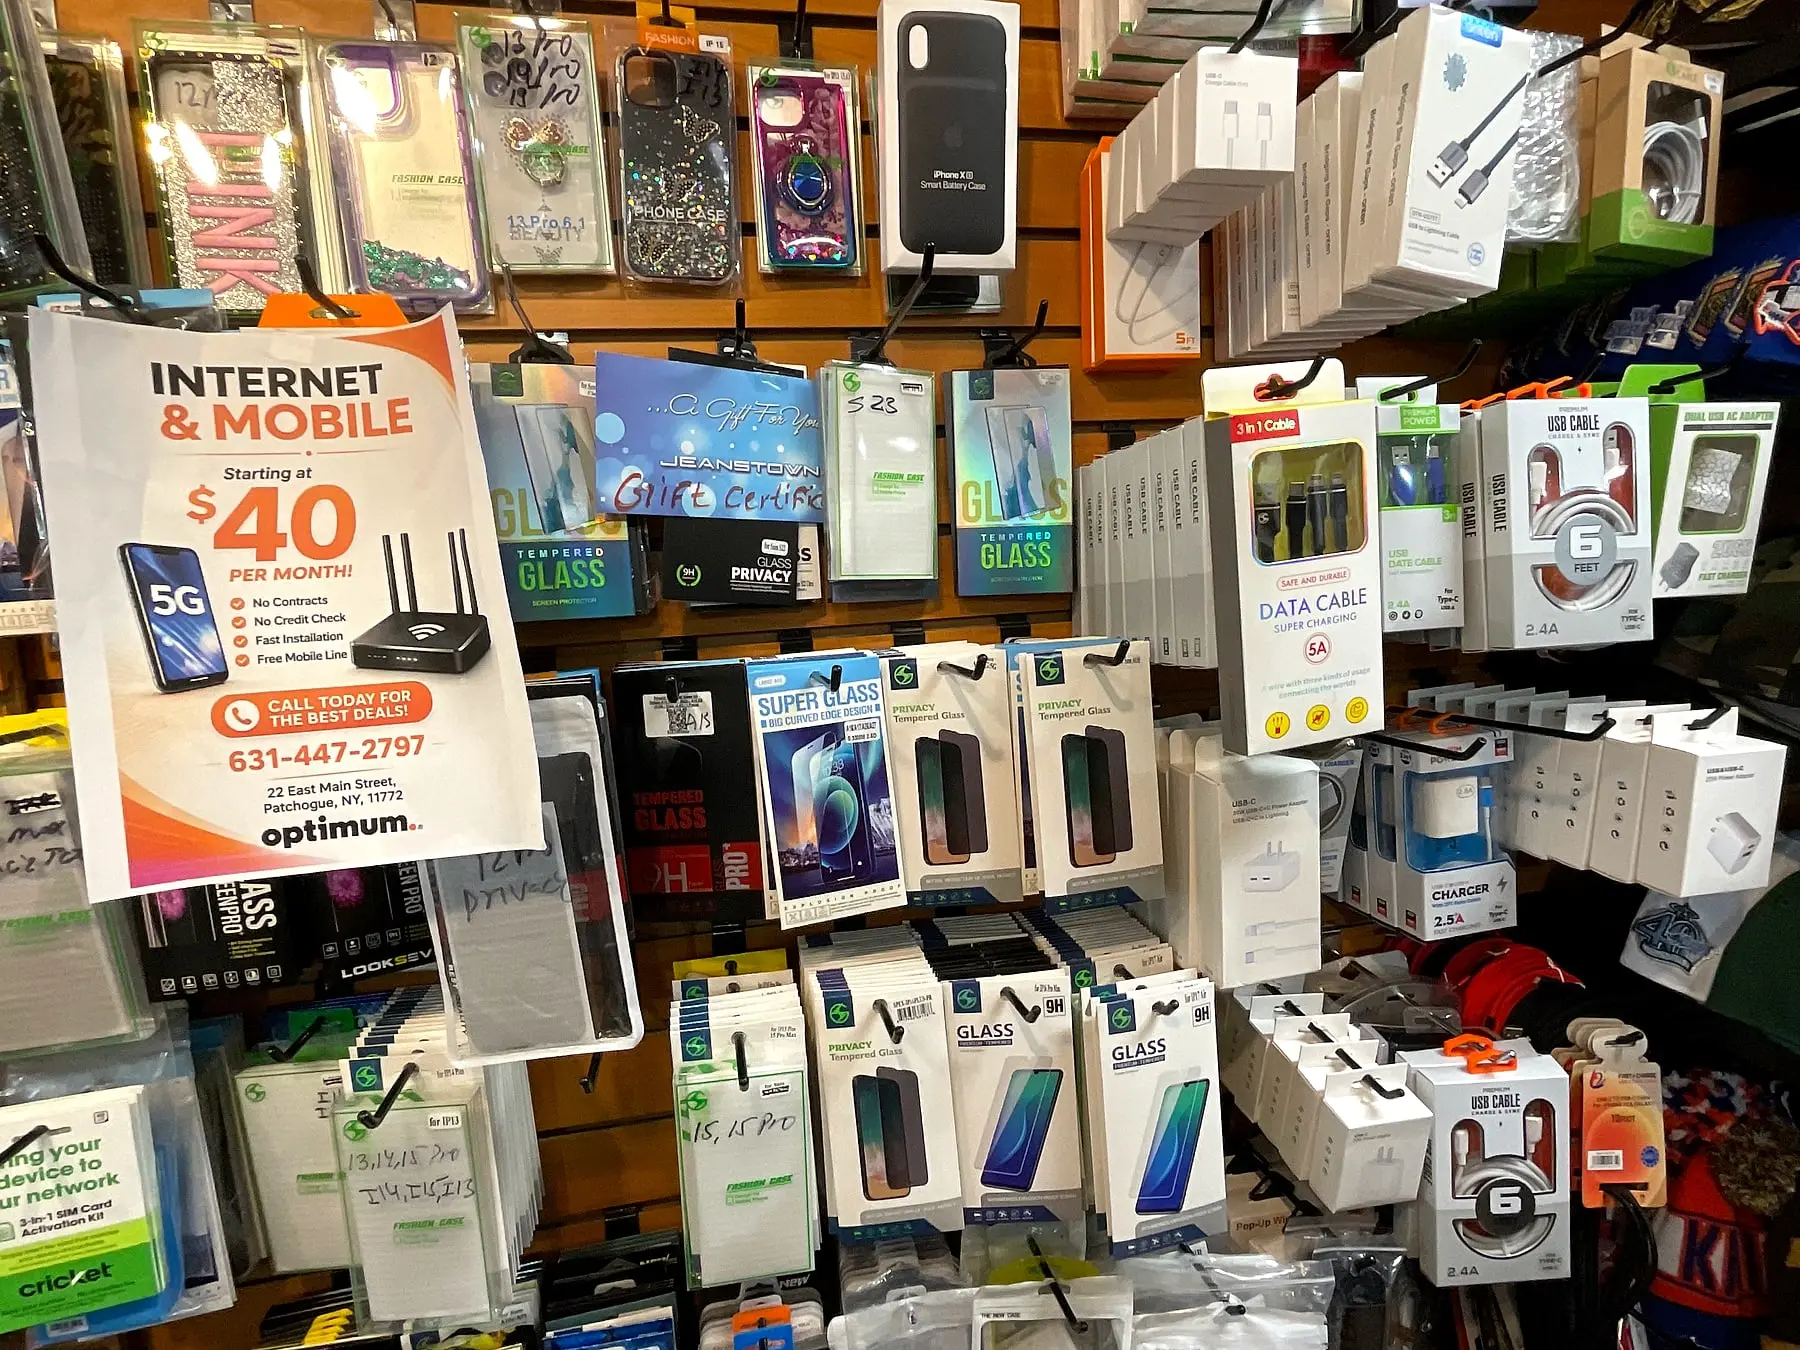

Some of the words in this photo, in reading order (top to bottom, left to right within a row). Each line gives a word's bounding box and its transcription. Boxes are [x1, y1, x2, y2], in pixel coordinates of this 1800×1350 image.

[645, 33, 695, 46] FASHION
[392, 174, 433, 183] FASHION
[438, 176, 464, 184] CASE
[934, 170, 957, 180] iPhone
[920, 181, 940, 190] Smart
[942, 182, 966, 190] Battery
[968, 182, 986, 190] Case
[635, 206, 683, 220] PHONE
[687, 209, 725, 221] CASE
[151, 362, 383, 397] INTERNET
[160, 404, 201, 440] &
[213, 398, 413, 440] MOBILE
[706, 398, 750, 431] Gift
[749, 401, 786, 425] For
[790, 409, 820, 435] You
[1548, 416, 1566, 431] USB
[1570, 415, 1599, 430] CABLE
[1684, 412, 1706, 422] DUAL
[1708, 412, 1724, 421] USB
[1727, 412, 1737, 420] AC
[1740, 412, 1774, 420] ADAPTER
[1237, 424, 1244, 435] 3
[1246, 423, 1254, 433] in
[1257, 420, 1261, 432] 1
[1264, 418, 1295, 432] Cable
[659, 456, 821, 477] JEANSTOWN
[224, 468, 291, 482] Starting
[296, 468, 312, 478] at
[873, 472, 904, 480] FASHION
[1492, 473, 1505, 498] USB
[1462, 482, 1474, 506] USB
[186, 484, 356, 561] $40
[1463, 508, 1476, 538] CABLE
[1493, 501, 1507, 532] CABLE
[981, 532, 1051, 542] TEMPERED
[1569, 525, 1603, 559] 6
[517, 547, 604, 558] TEMPERED
[981, 542, 1051, 569] GLASS
[758, 557, 791, 569] GLASS
[1389, 560, 1412, 568] DATE
[1415, 558, 1442, 566] CABLE
[1574, 562, 1600, 573] FEET
[229, 568, 266, 582] PER
[273, 565, 352, 581] MONTH!
[518, 559, 606, 591] GLASS
[732, 567, 792, 582] PRIVACY
[1281, 577, 1300, 588] SAFE
[1301, 575, 1317, 584] AND
[1319, 570, 1347, 582] DURABLE
[150, 585, 206, 616] 5G
[253, 598, 270, 607] No
[273, 596, 328, 607] Contracts
[532, 599, 557, 607] SCREEN
[559, 597, 597, 605] PROTECTOR
[1259, 599, 1310, 620] DATA
[1316, 588, 1367, 612] CABLE
[1388, 601, 1410, 609] 2.4A
[1437, 596, 1459, 604] Type-C
[254, 616, 271, 626] No
[274, 615, 308, 625] Credit
[311, 613, 346, 623] Check
[1274, 621, 1304, 633] SUPER
[1307, 612, 1357, 629] CHARGING
[1526, 624, 1559, 636] 2.4A
[256, 635, 280, 645] Fast
[283, 632, 343, 643] Installation
[1309, 641, 1326, 656] 5A
[257, 654, 282, 664] Free
[285, 651, 323, 662] Mobile
[326, 650, 348, 660] Line
[1303, 677, 1322, 685] three
[1323, 672, 1342, 681] kinds
[1351, 667, 1370, 675] usage
[1279, 686, 1320, 698] connecting
[1333, 680, 1356, 689] worlds
[267, 699, 314, 712] CALL
[318, 693, 375, 708] TODAY
[380, 690, 411, 703] FOR
[758, 692, 818, 716] SUPER
[823, 683, 879, 707] GLASS
[1038, 699, 1082, 710] PRIVACY
[769, 719, 783, 727] BIG
[785, 713, 818, 725] CURVED
[821, 710, 842, 720] EDGE
[844, 705, 873, 717] DESIGN
[892, 703, 935, 713] PRIVACY
[1039, 709, 1085, 722] Tempered
[1087, 706, 1111, 716] Glass
[270, 714, 303, 727] THE
[308, 710, 350, 724] BEST
[354, 706, 408, 720] DEALS!
[893, 713, 939, 724] Tempered
[941, 711, 965, 721] Glass
[229, 735, 425, 772] 631-447-2797
[1324, 759, 1354, 767] CHARGER
[267, 787, 283, 798] 22
[288, 784, 316, 795] East
[320, 781, 351, 793] Main
[355, 778, 396, 790] Street,
[264, 798, 338, 814] Patchogue,
[342, 795, 363, 806] NY,
[368, 790, 403, 803] 11772
[633, 790, 703, 805] TEMPERED
[1232, 798, 1256, 807] USB-C
[635, 808, 706, 830] GLASS
[1432, 884, 1489, 900] CHARGER
[1434, 913, 1464, 927] 2.5A
[1046, 1000, 1063, 1014] 9H
[1195, 1005, 1209, 1022] 9H
[957, 1023, 1014, 1039] GLASS
[829, 1041, 873, 1051] PRIVACY
[1112, 1038, 1166, 1061] GLASS
[830, 1051, 876, 1062] Tempered
[879, 1048, 903, 1058] Glass
[1472, 1096, 1489, 1109] USB
[1493, 1094, 1520, 1108] CABLE
[430, 1117, 440, 1126] for
[443, 1116, 459, 1125] IP13
[49, 1139, 102, 1159] your
[80, 1159, 102, 1173] to
[26, 1173, 120, 1205] network
[726, 1178, 766, 1191] FASHION
[769, 1174, 793, 1186] CASE
[1489, 1187, 1521, 1215] 6
[56, 1207, 78, 1219] SIM
[81, 1200, 113, 1213] Card
[22, 1217, 85, 1237] Activation
[88, 1212, 104, 1222] Kit
[394, 1220, 433, 1230] FASHION
[439, 1217, 465, 1228] CASE
[1448, 1266, 1479, 1277] 2.4A
[19, 1263, 114, 1298] cricket
[778, 1274, 810, 1290] NEW
